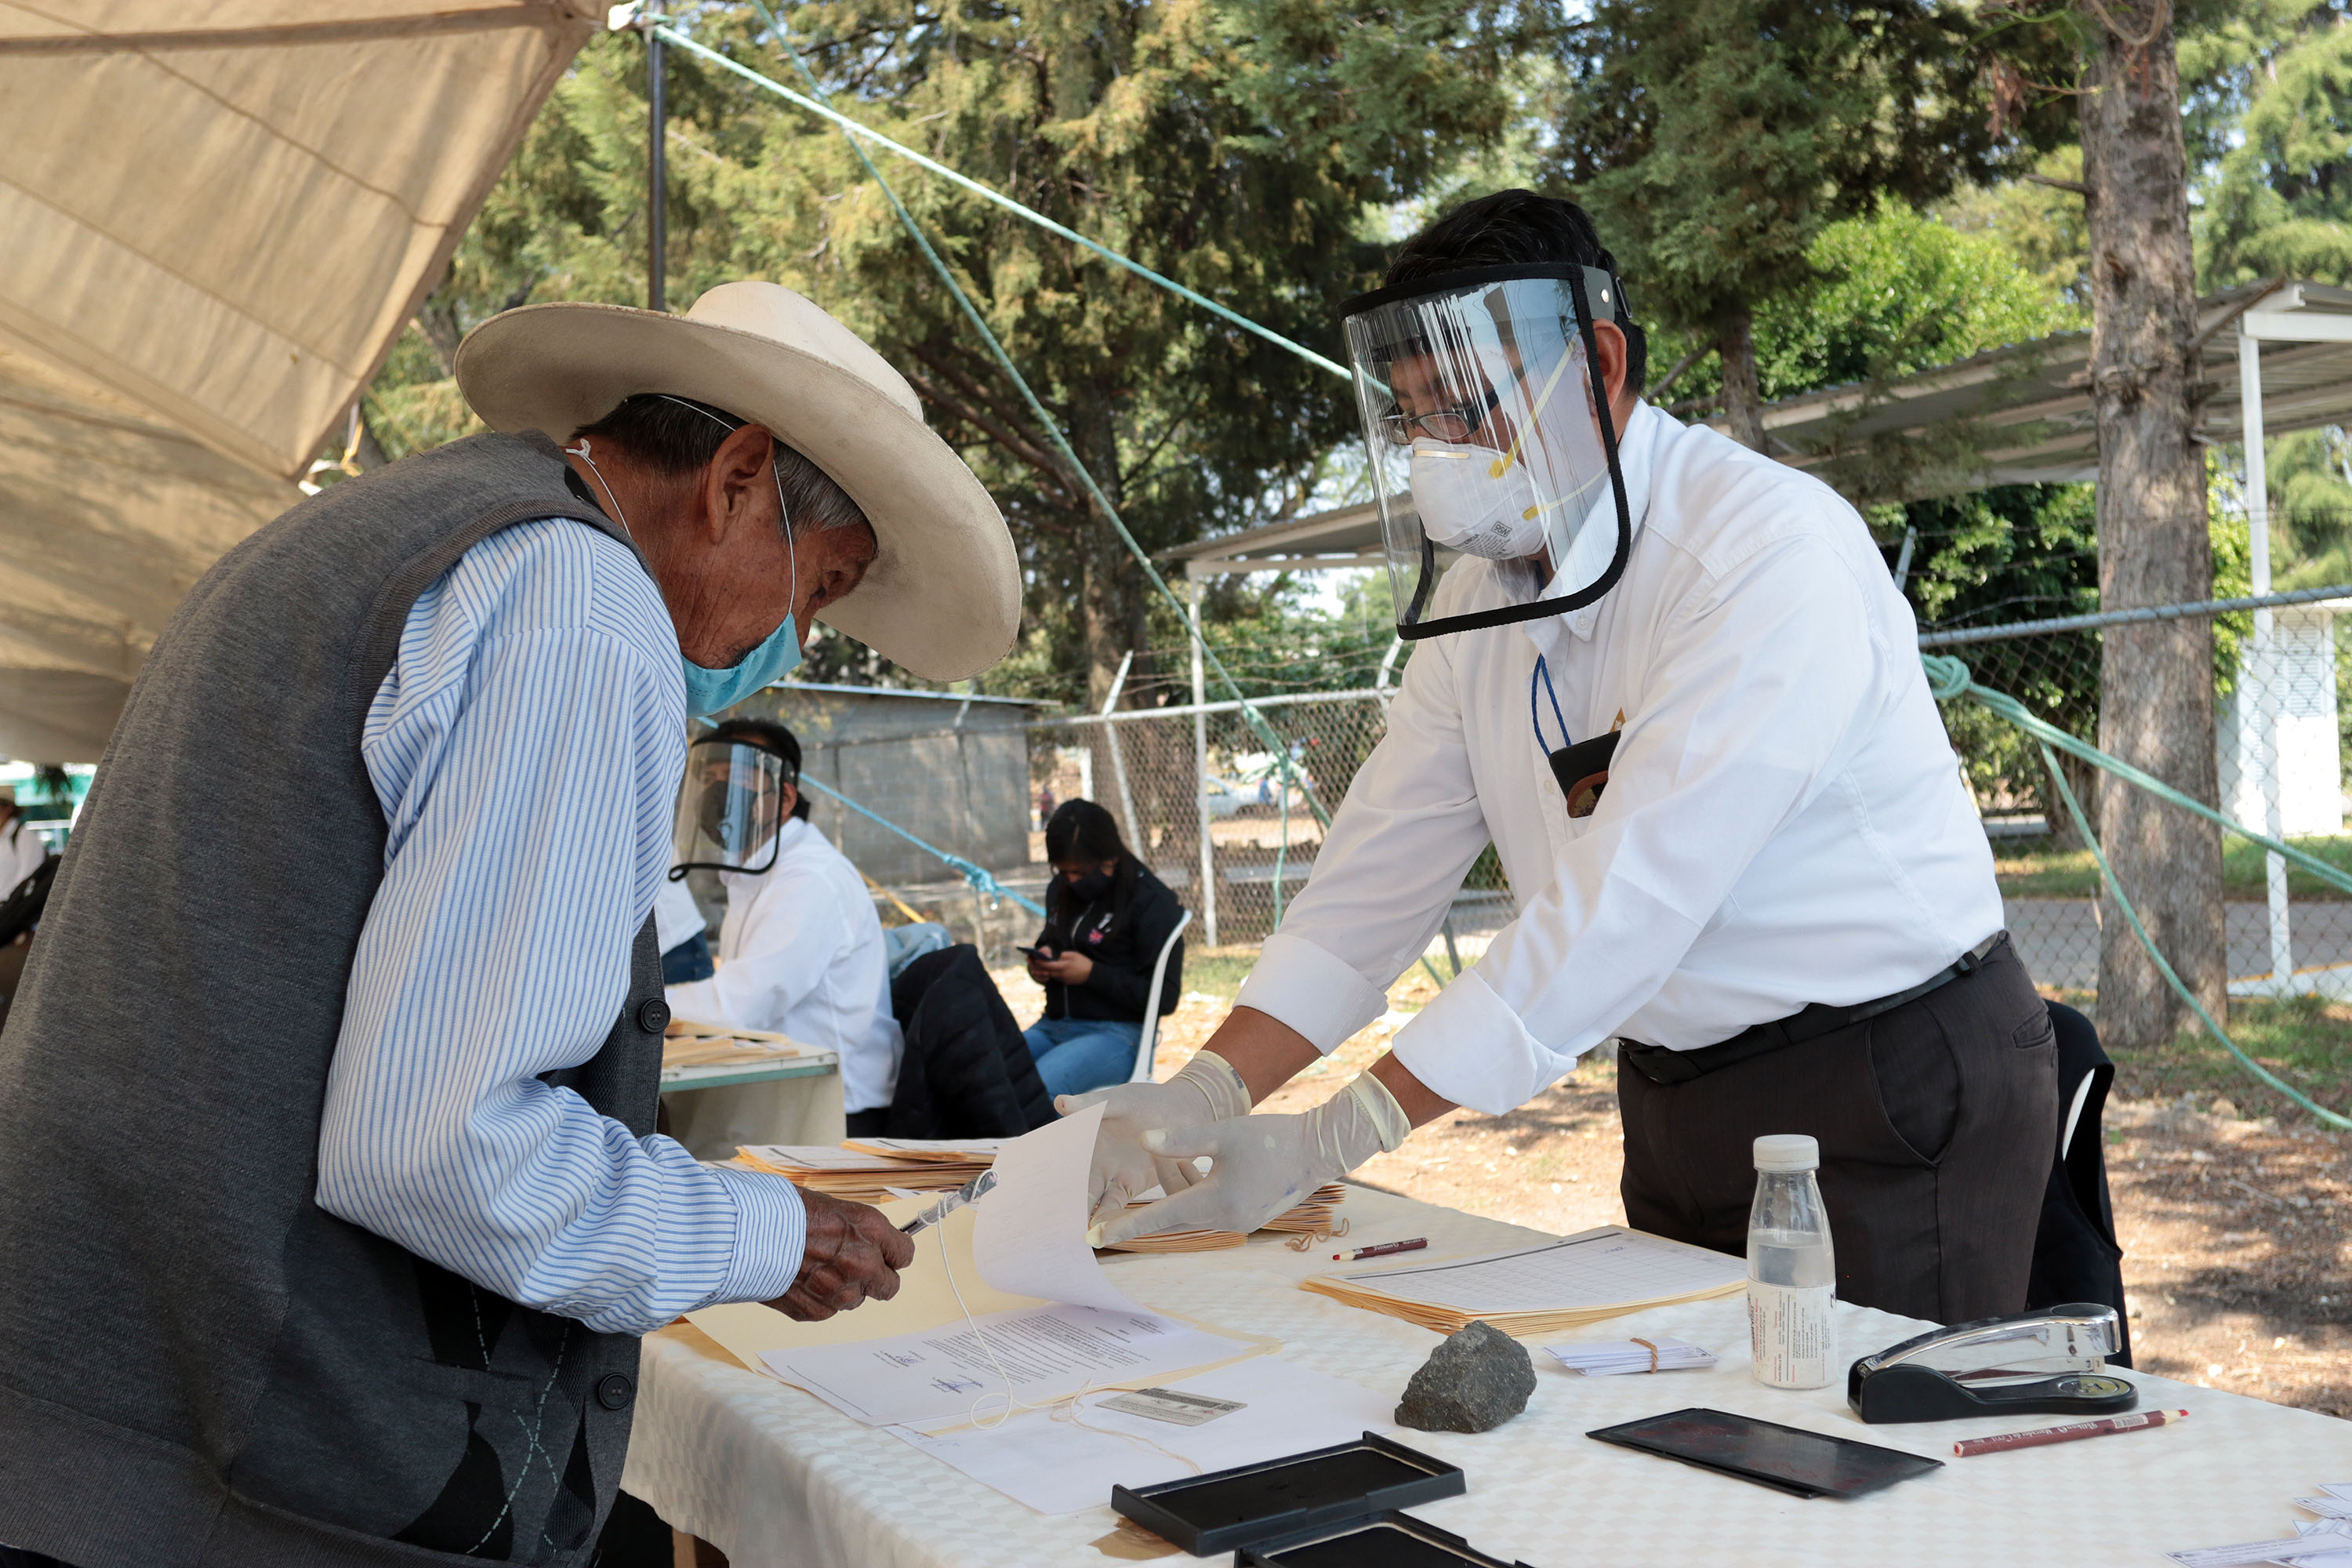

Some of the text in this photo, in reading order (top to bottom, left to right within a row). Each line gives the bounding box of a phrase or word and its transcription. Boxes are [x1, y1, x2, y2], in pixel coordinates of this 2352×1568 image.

[1494, 523, 1509, 535] N95
[2066, 1421, 2097, 1431] Pelikan
[1991, 1434, 2013, 1443] Cera
